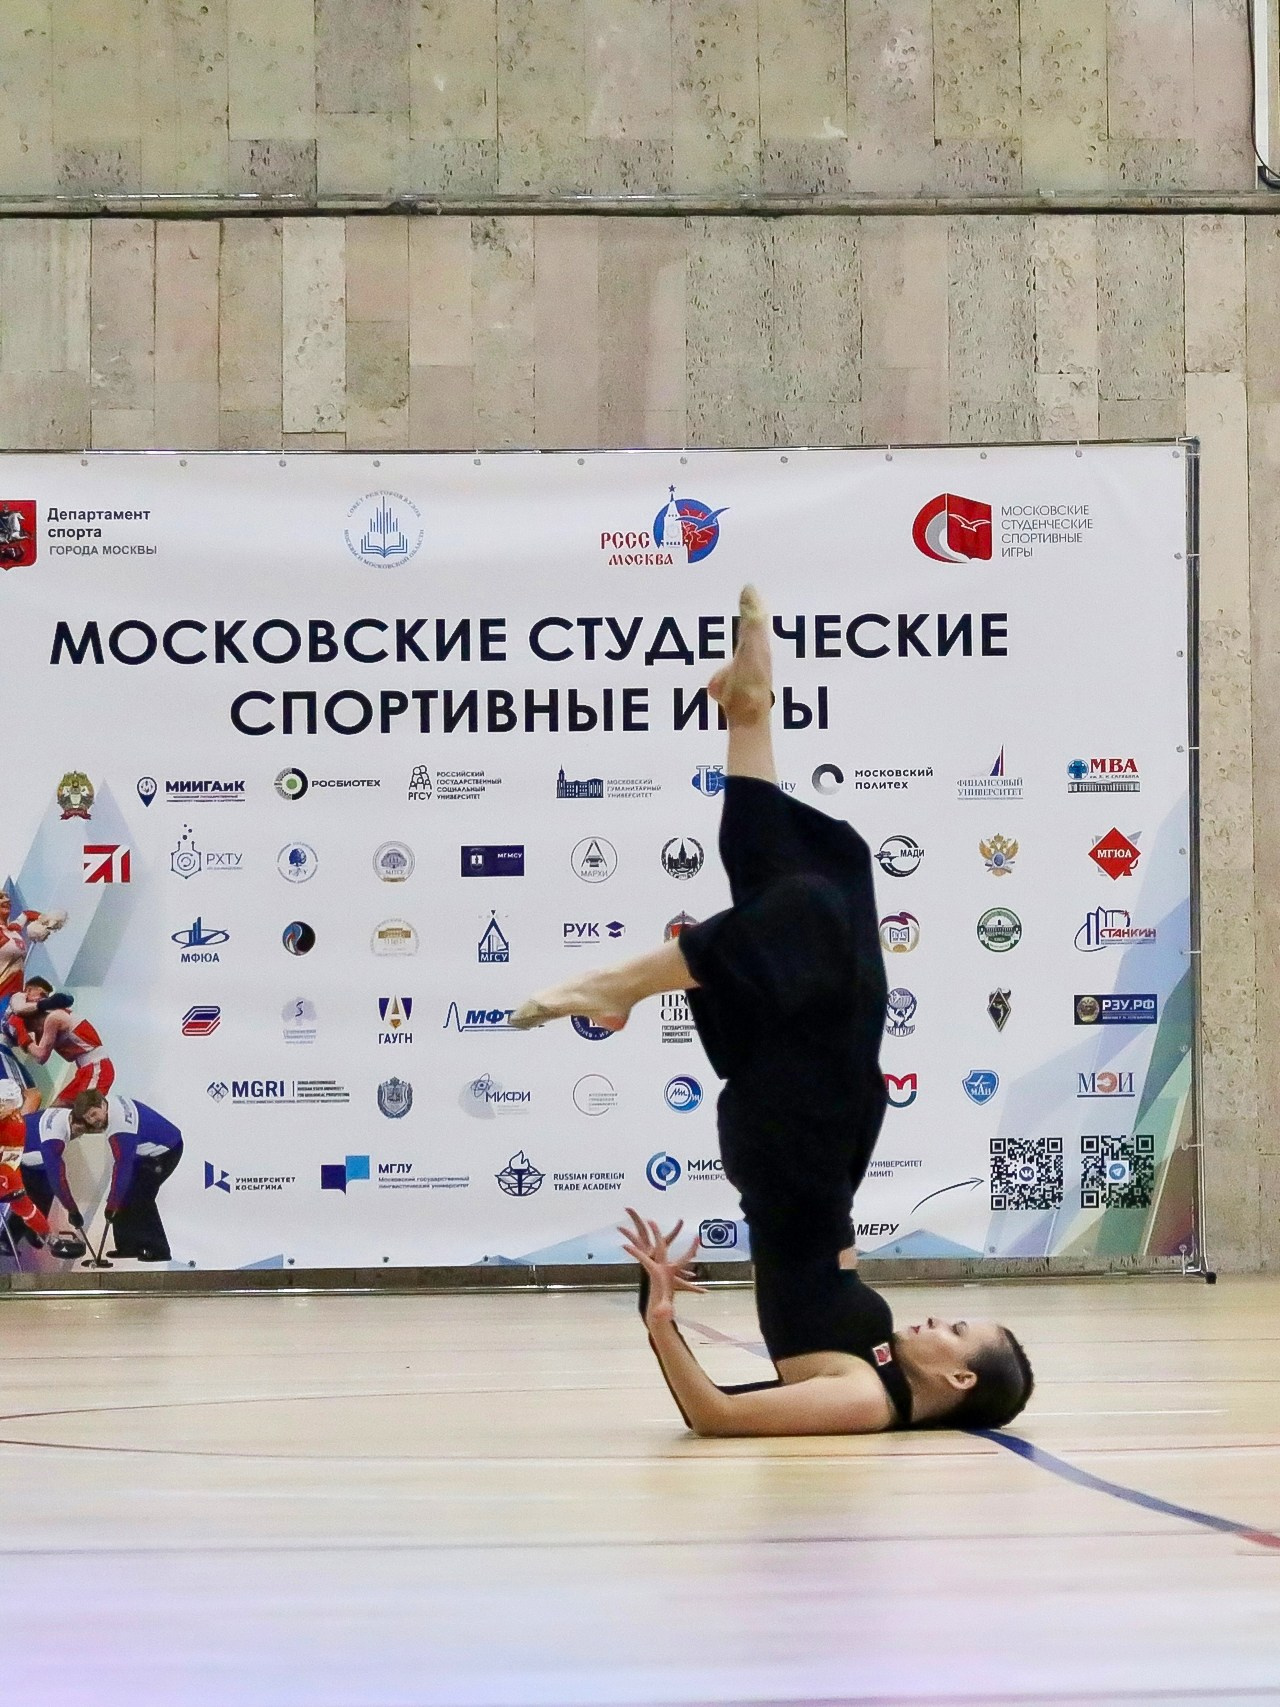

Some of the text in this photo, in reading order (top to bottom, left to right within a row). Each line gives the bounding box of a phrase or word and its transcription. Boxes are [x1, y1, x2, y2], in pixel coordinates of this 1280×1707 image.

[47, 507, 151, 523] Департамент
[1001, 504, 1090, 516] МОСКОВСКИЕ
[1001, 518, 1094, 531] СТУДЕНЧЕСКИЕ
[47, 528, 102, 541] спорта
[600, 532, 650, 549] РССС
[1001, 532, 1083, 544] СПОРТИВНЫЕ
[50, 545, 157, 557] ГОРОДА МОСКВЫ
[1001, 547, 1033, 558] ИГРЫ
[608, 553, 674, 566] МОСКВА
[50, 613, 1008, 665] МОСКОВСКИЕ СТУДЕЧЕСКИЕ
[230, 686, 829, 735] СПОРТИВНЫЕ ИЫ
[1090, 758, 1138, 773] МВА
[165, 780, 245, 792] МИИГАиК
[311, 780, 381, 788] РОСБИОТЕХ
[957, 777, 1023, 787] ФИНАНСОВЫЙ
[408, 792, 432, 800] РГСУ
[957, 788, 1023, 797] УНИВЕРСИТЕТ
[207, 853, 243, 866] РХТУ
[900, 849, 924, 859] МАДИ
[1097, 849, 1132, 859] МГЮА
[563, 923, 600, 937] РУК
[1100, 929, 1157, 938] СТАНКИН
[180, 953, 220, 963] МФЮА
[480, 954, 508, 962] МГСУ
[1102, 999, 1155, 1011] РЭУ.РФ
[378, 1033, 413, 1044] ГАУГН
[232, 1080, 285, 1097] MGRI
[1078, 1072, 1134, 1093] МЭИ
[485, 1091, 531, 1102] МИФИ
[378, 1164, 413, 1174] МГЛУ
[688, 1160, 724, 1172] МИС
